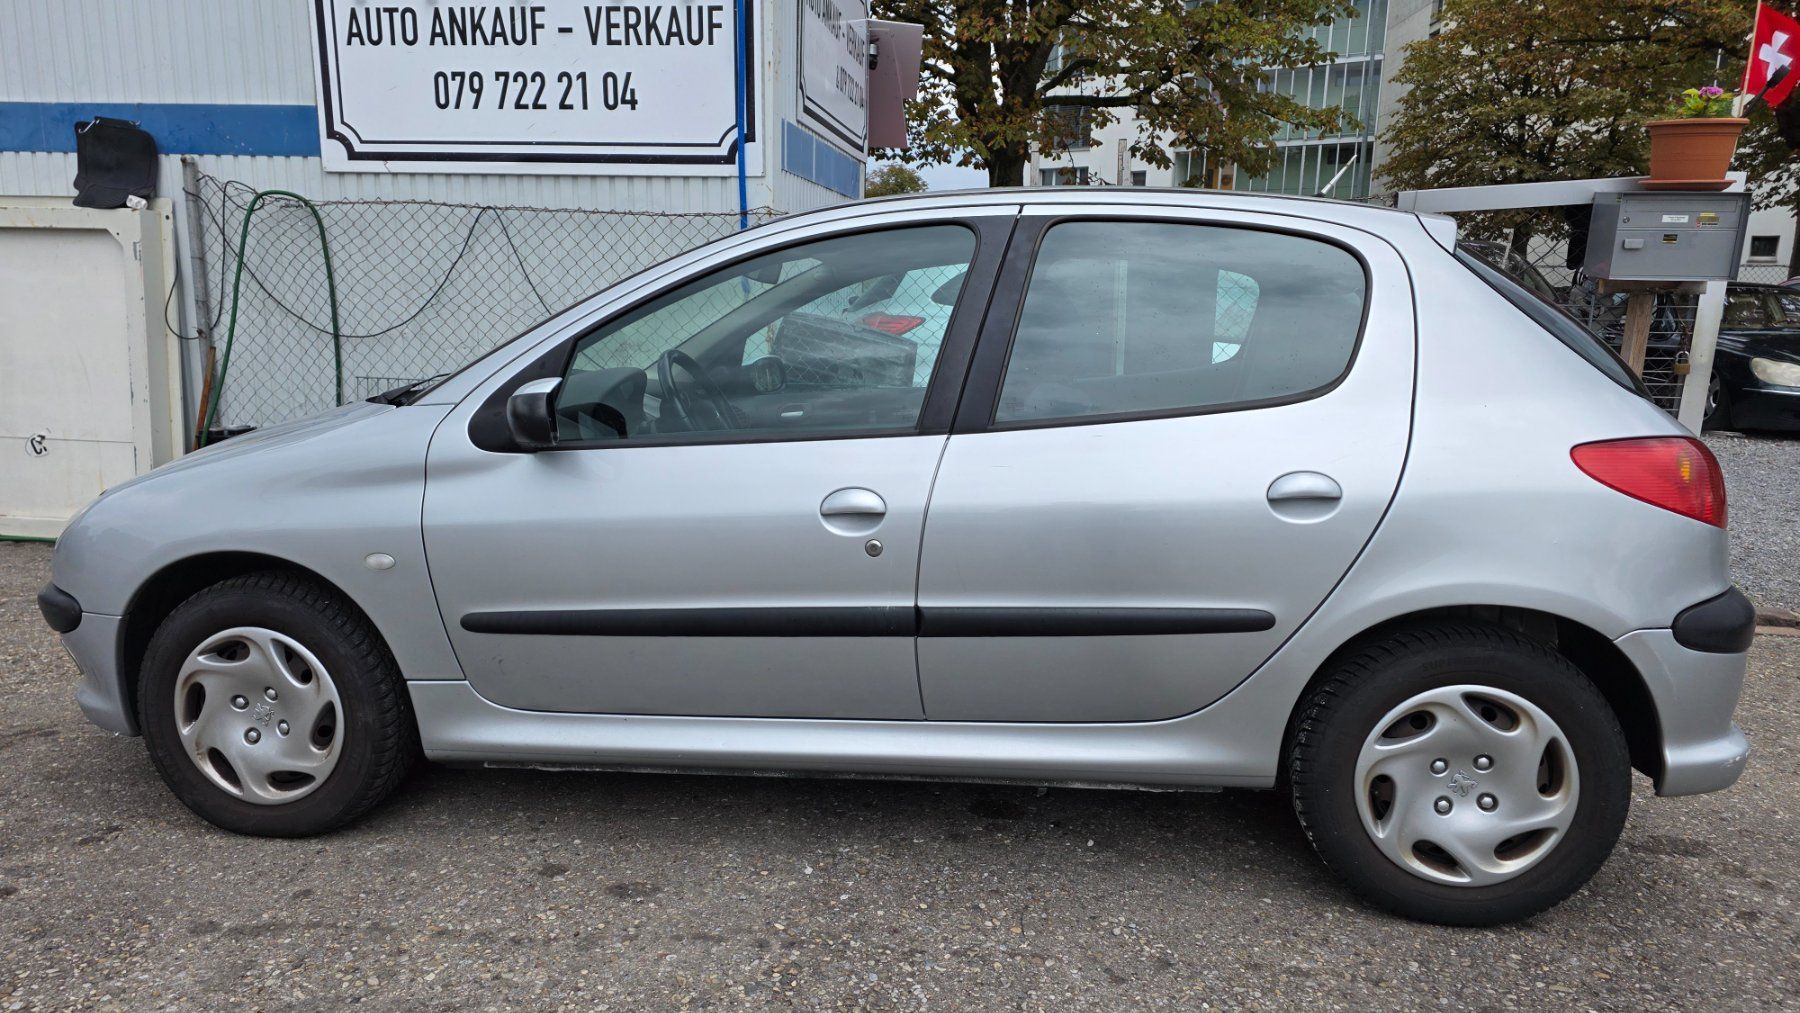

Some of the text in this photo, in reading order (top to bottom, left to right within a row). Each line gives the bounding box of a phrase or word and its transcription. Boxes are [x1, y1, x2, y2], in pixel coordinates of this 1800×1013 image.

[346, 7, 419, 46] AUTO
[429, 6, 546, 46] ANKAUF
[583, 5, 724, 46] VERKAUF
[433, 70, 638, 111] 079 722 21 04
